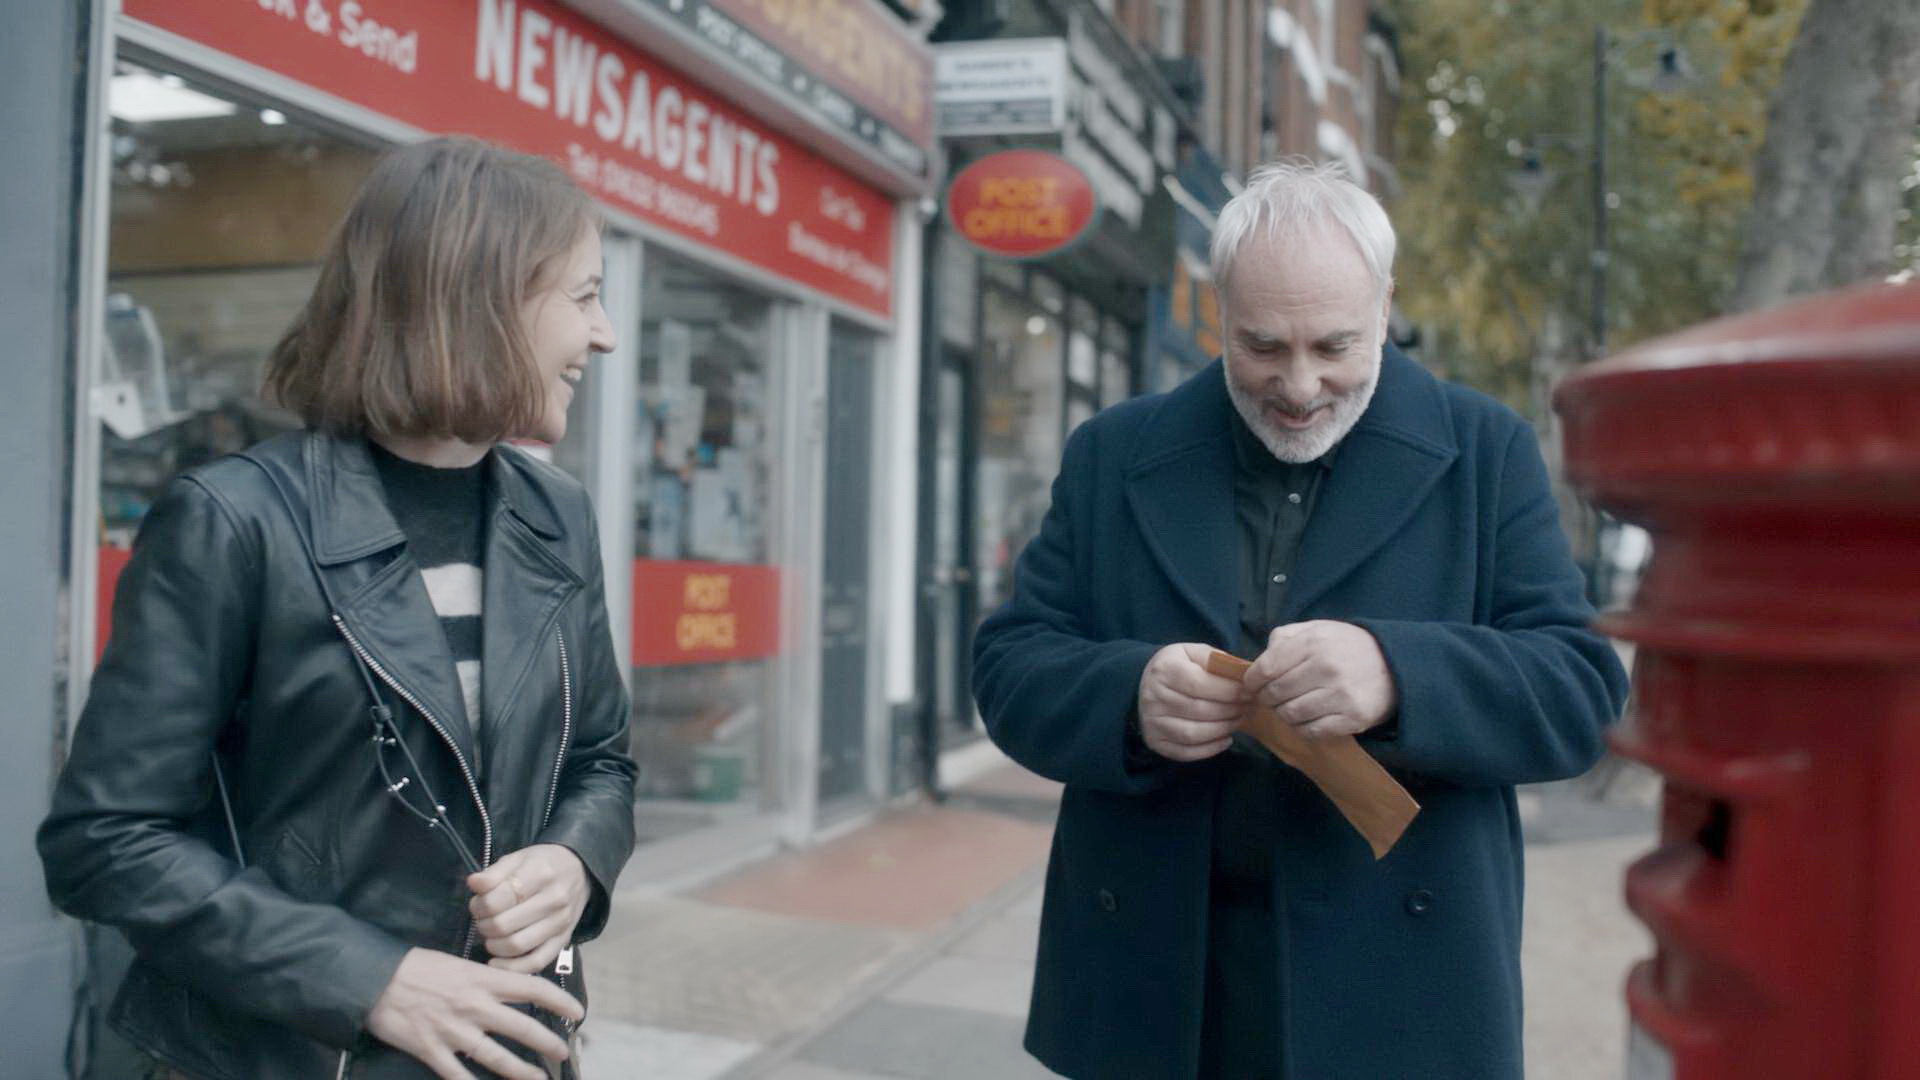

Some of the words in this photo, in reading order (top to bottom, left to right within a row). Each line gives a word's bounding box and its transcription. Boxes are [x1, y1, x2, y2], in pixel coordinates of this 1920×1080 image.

[304, 0, 331, 36] &
[339, 0, 417, 74] Send
[475, 0, 780, 216] NEWSAGENTS
[980, 176, 1058, 208] POST
[965, 206, 1070, 239] OFFICE
[684, 573, 731, 611] POST
[676, 612, 737, 651] OFFICE
